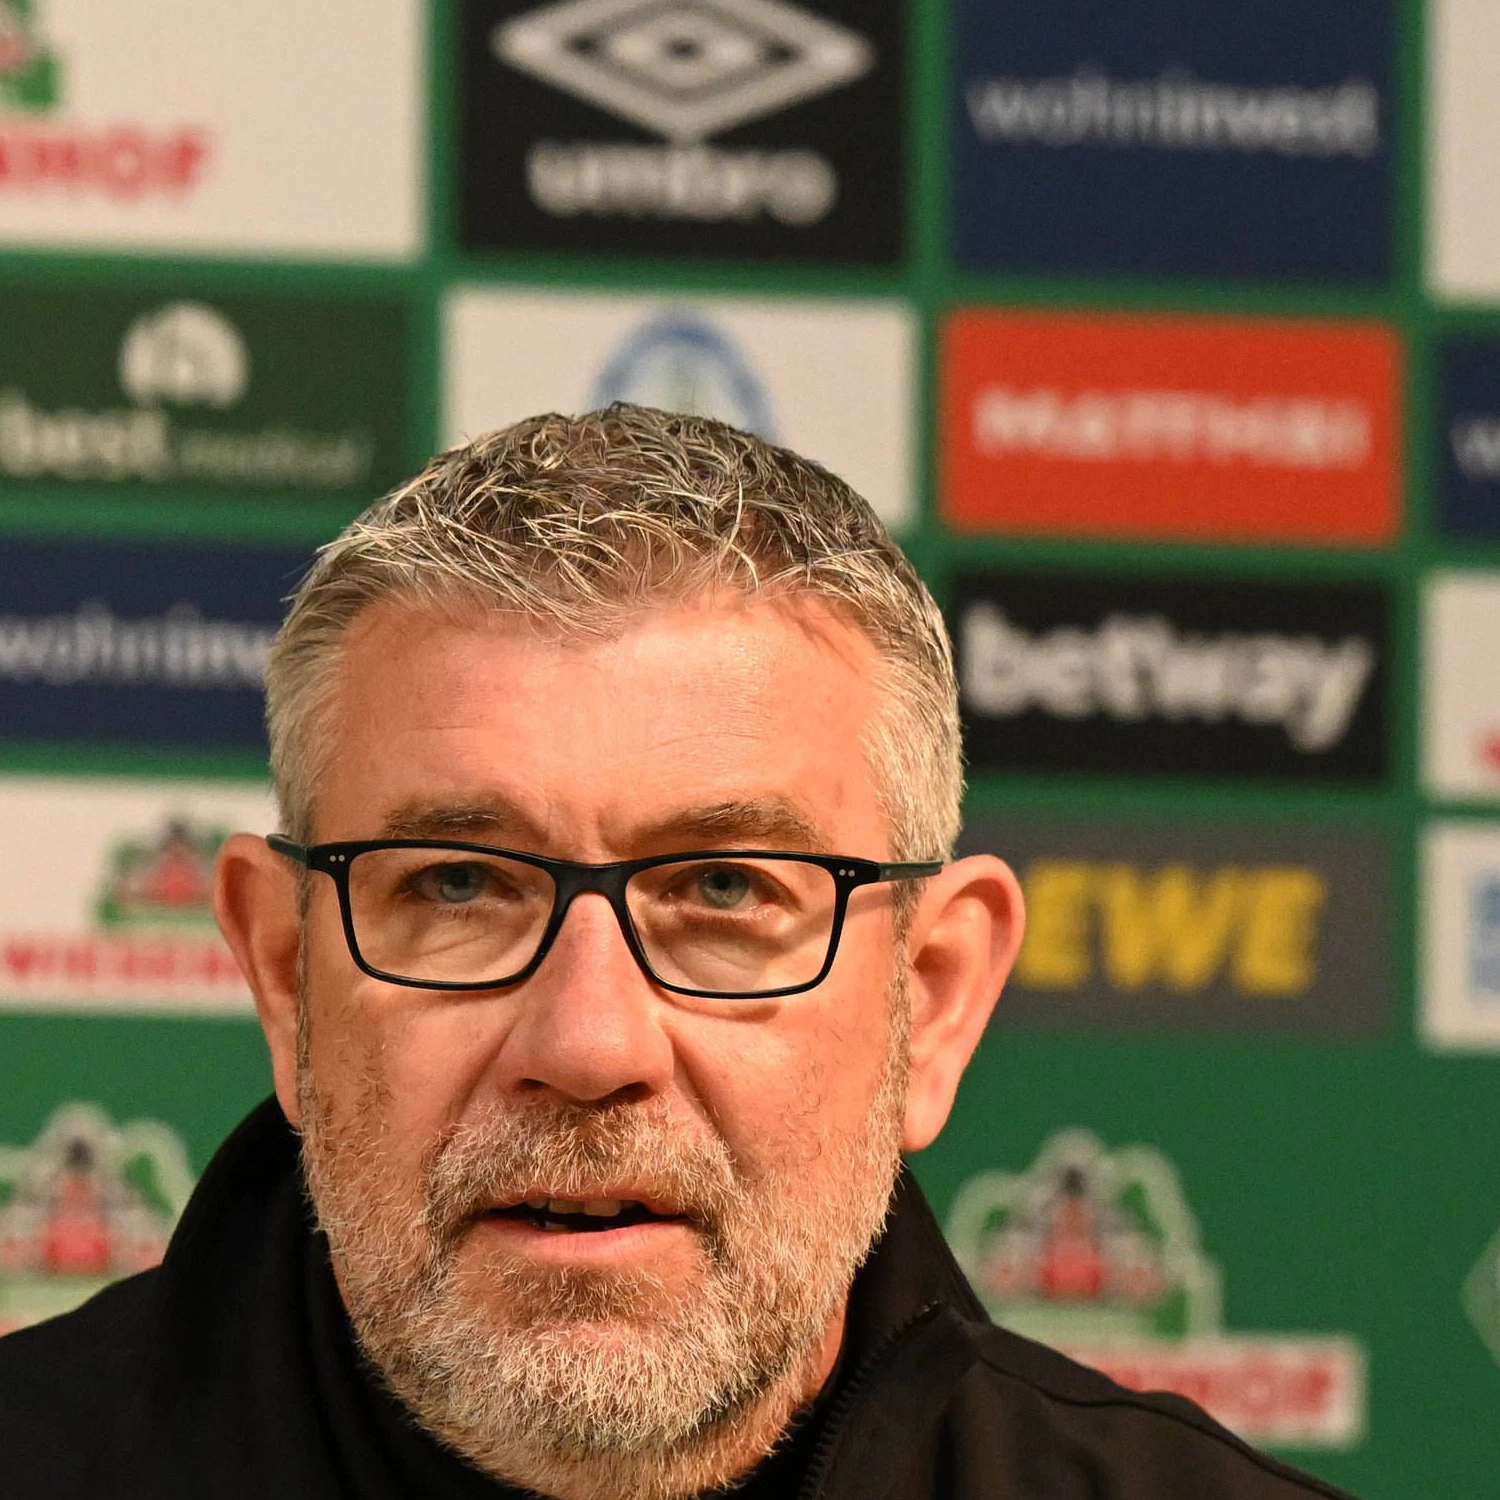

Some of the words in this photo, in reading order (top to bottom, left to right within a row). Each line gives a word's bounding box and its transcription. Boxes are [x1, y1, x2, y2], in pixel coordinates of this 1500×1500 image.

[966, 68, 1380, 156] wohninvest
[528, 142, 836, 224] umbro
[962, 606, 1372, 749] betway
[1018, 862, 1325, 994] EWE
